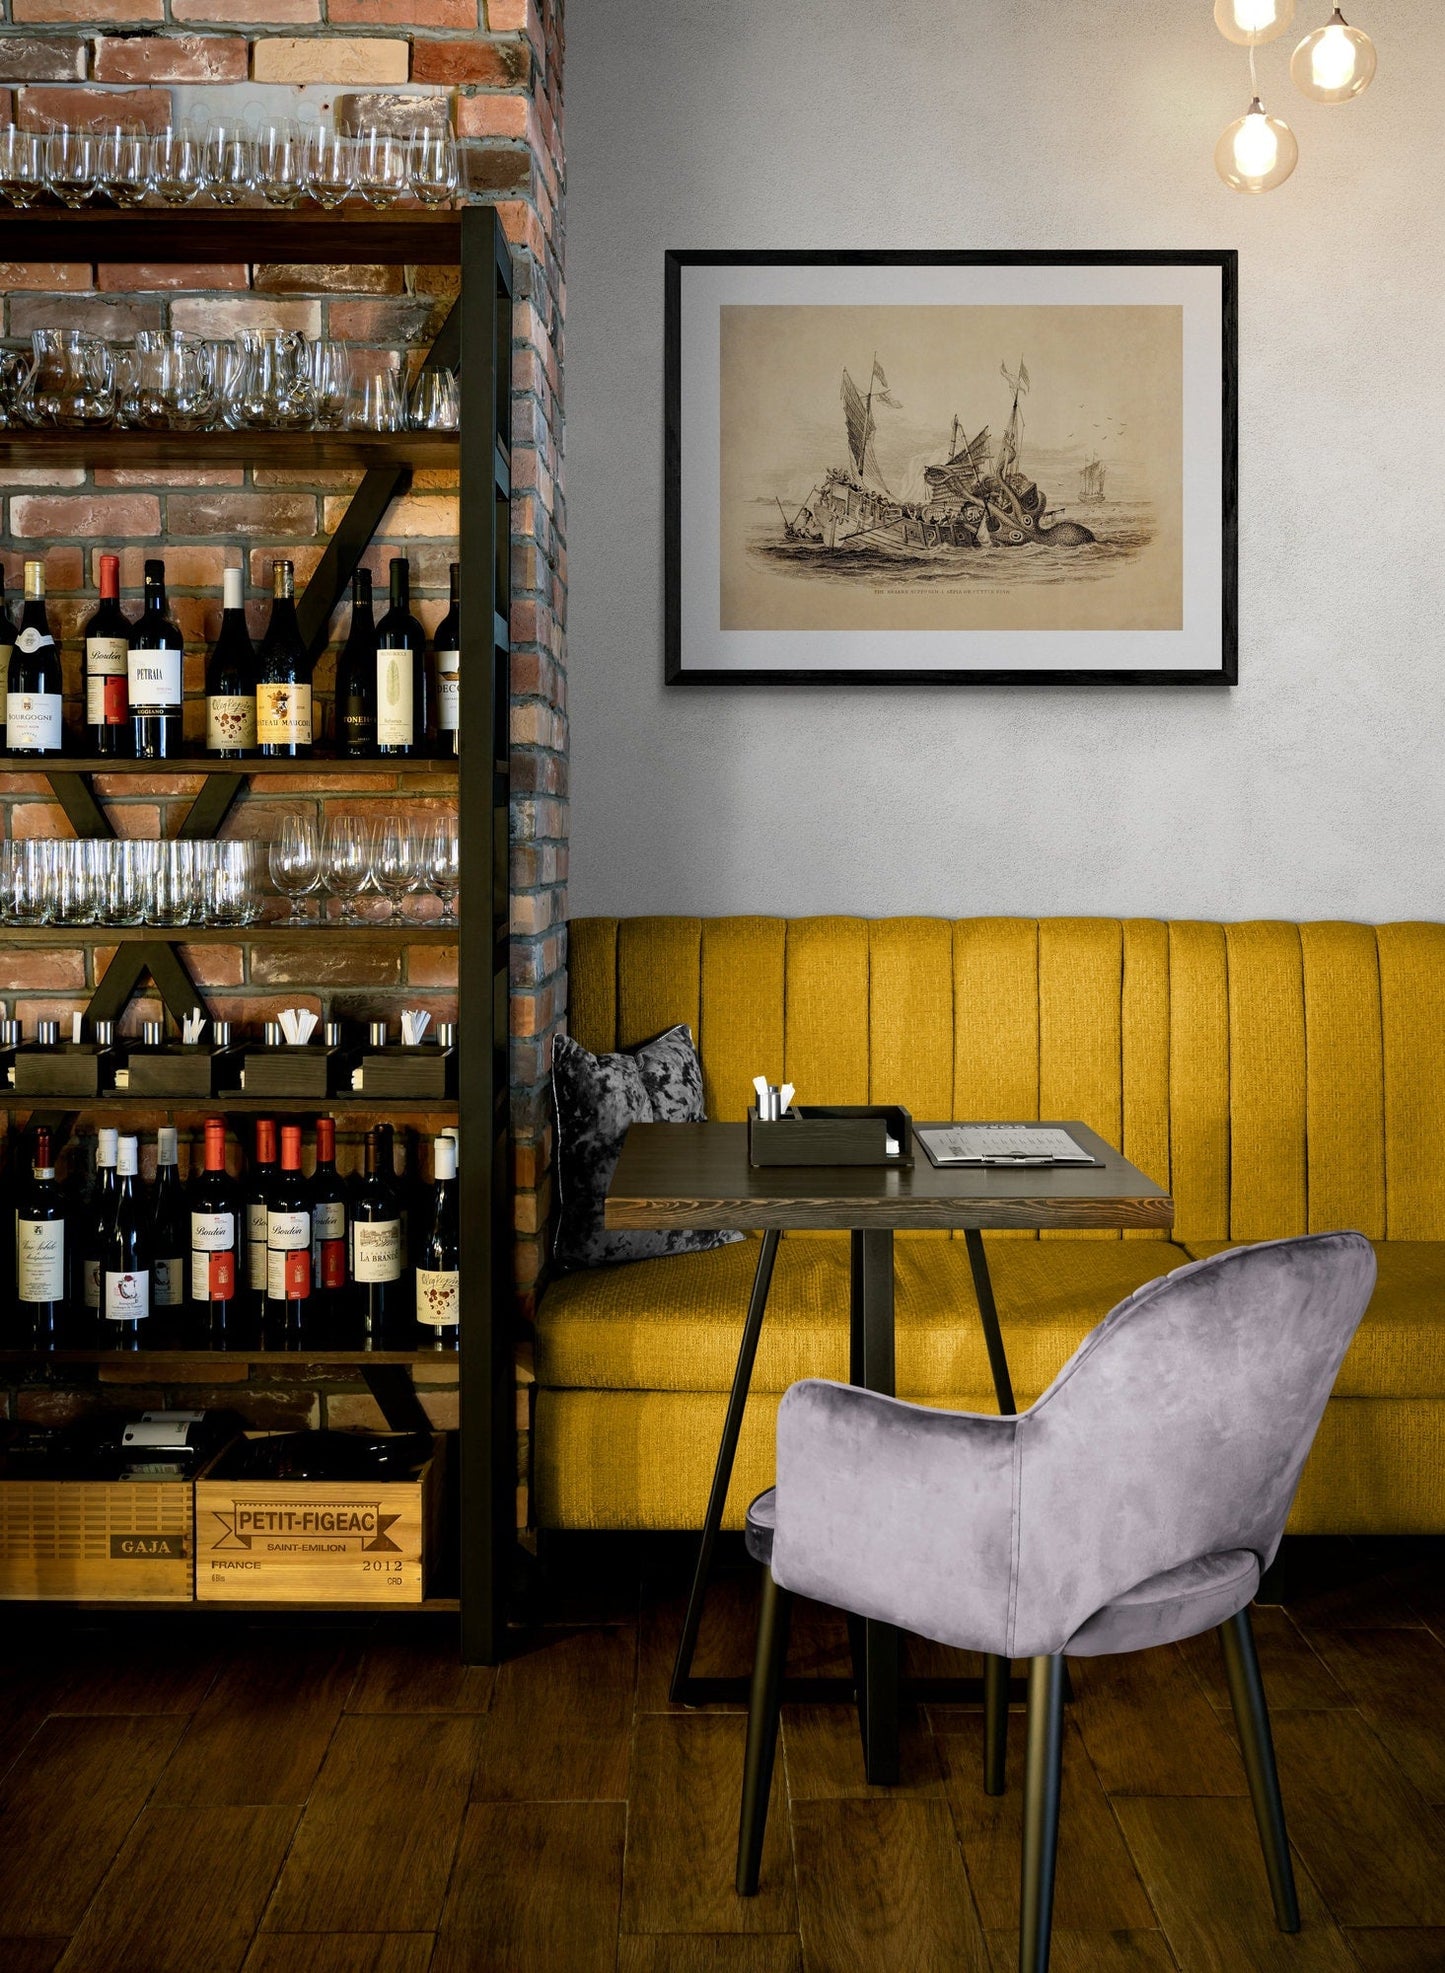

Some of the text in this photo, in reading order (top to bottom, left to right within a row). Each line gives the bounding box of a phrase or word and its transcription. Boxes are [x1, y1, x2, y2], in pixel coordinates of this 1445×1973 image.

[8, 713, 52, 721] BOURGOGNE
[239, 1511, 375, 1532] PETIT-FIGEAC
[121, 1540, 172, 1554] GAJA
[267, 1543, 347, 1553] SAINT-EMILION
[211, 1560, 403, 1572] FRANCE 2012
